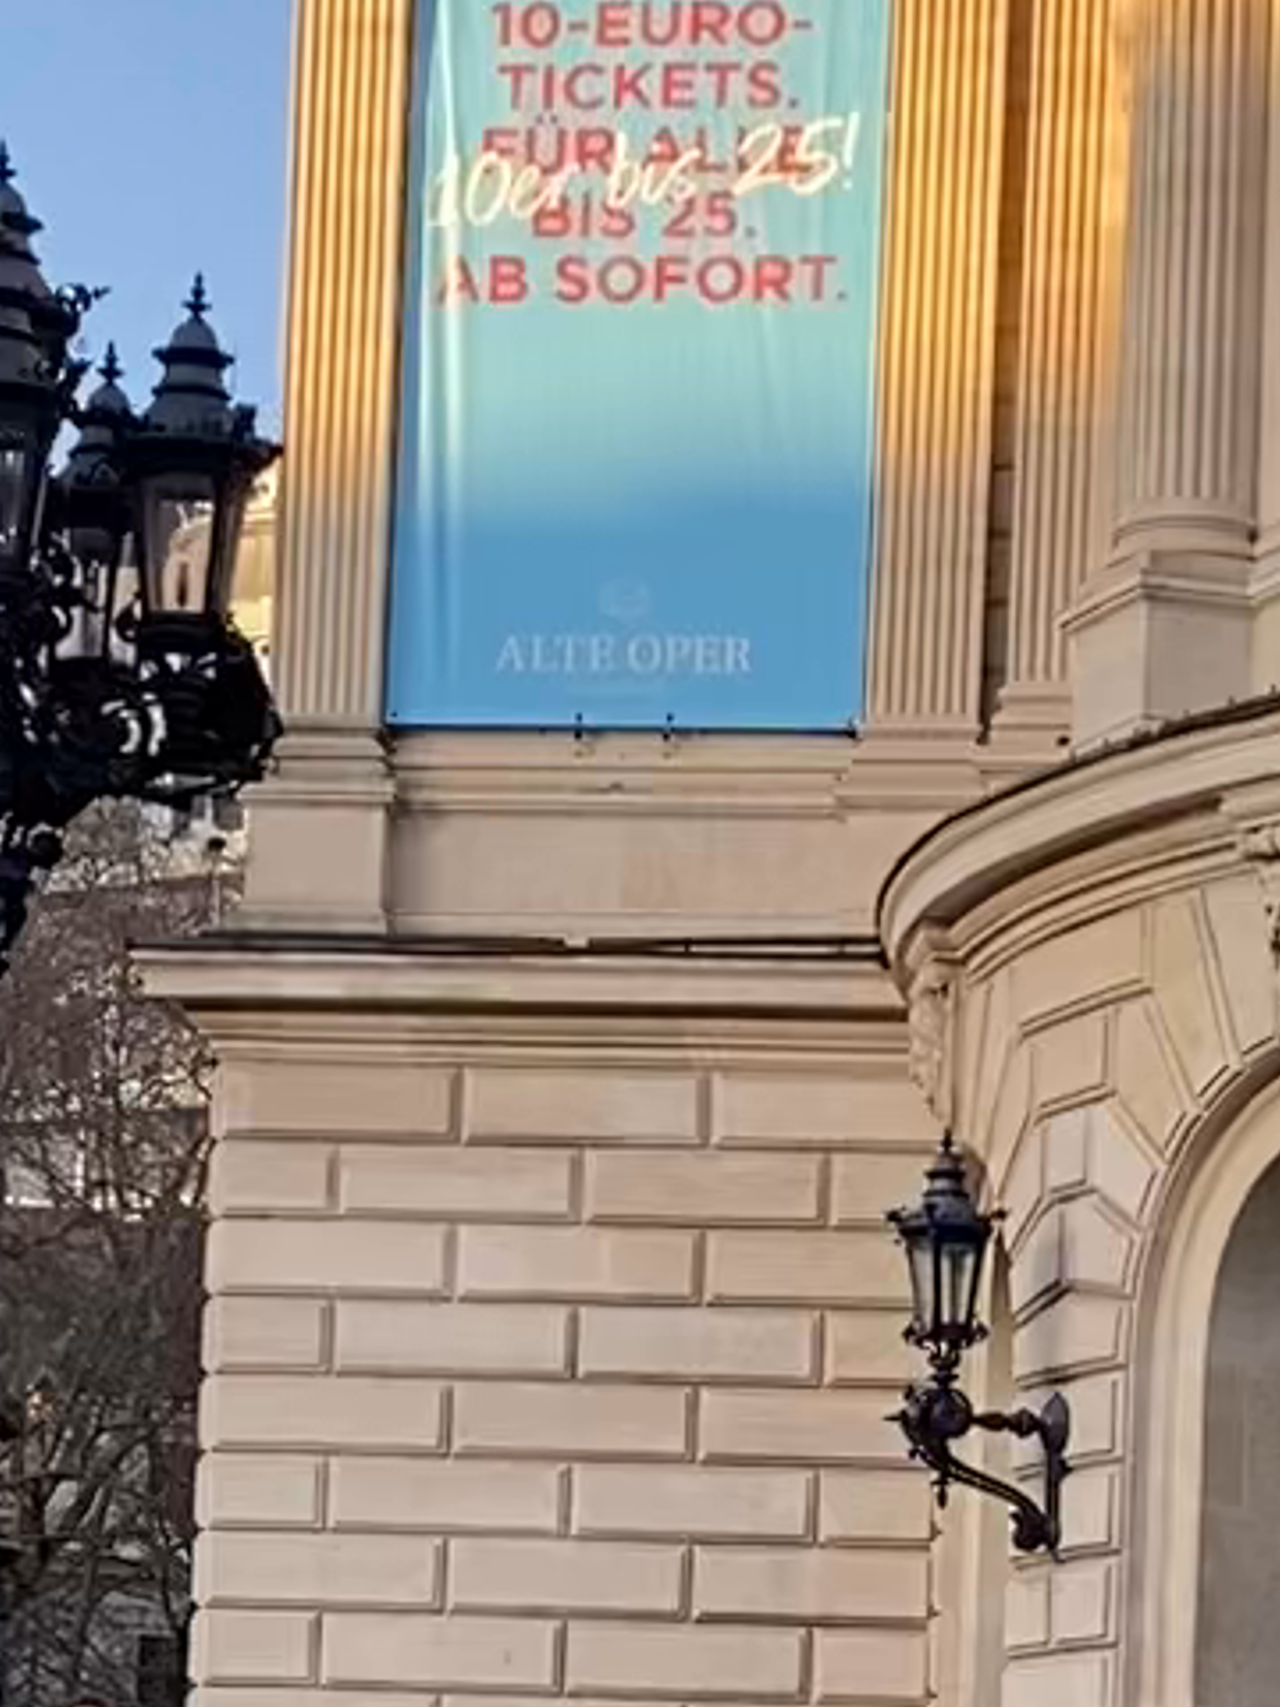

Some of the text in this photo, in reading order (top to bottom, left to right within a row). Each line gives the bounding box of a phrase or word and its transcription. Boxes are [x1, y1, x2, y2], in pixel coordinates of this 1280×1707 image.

[498, 60, 798, 111] TICKETS.
[483, 115, 618, 176] FÜR
[732, 110, 860, 196] 25!
[532, 186, 757, 238] BIS 25.
[440, 254, 847, 303] AB SOFORT.
[496, 633, 753, 675] ALTE OPER
